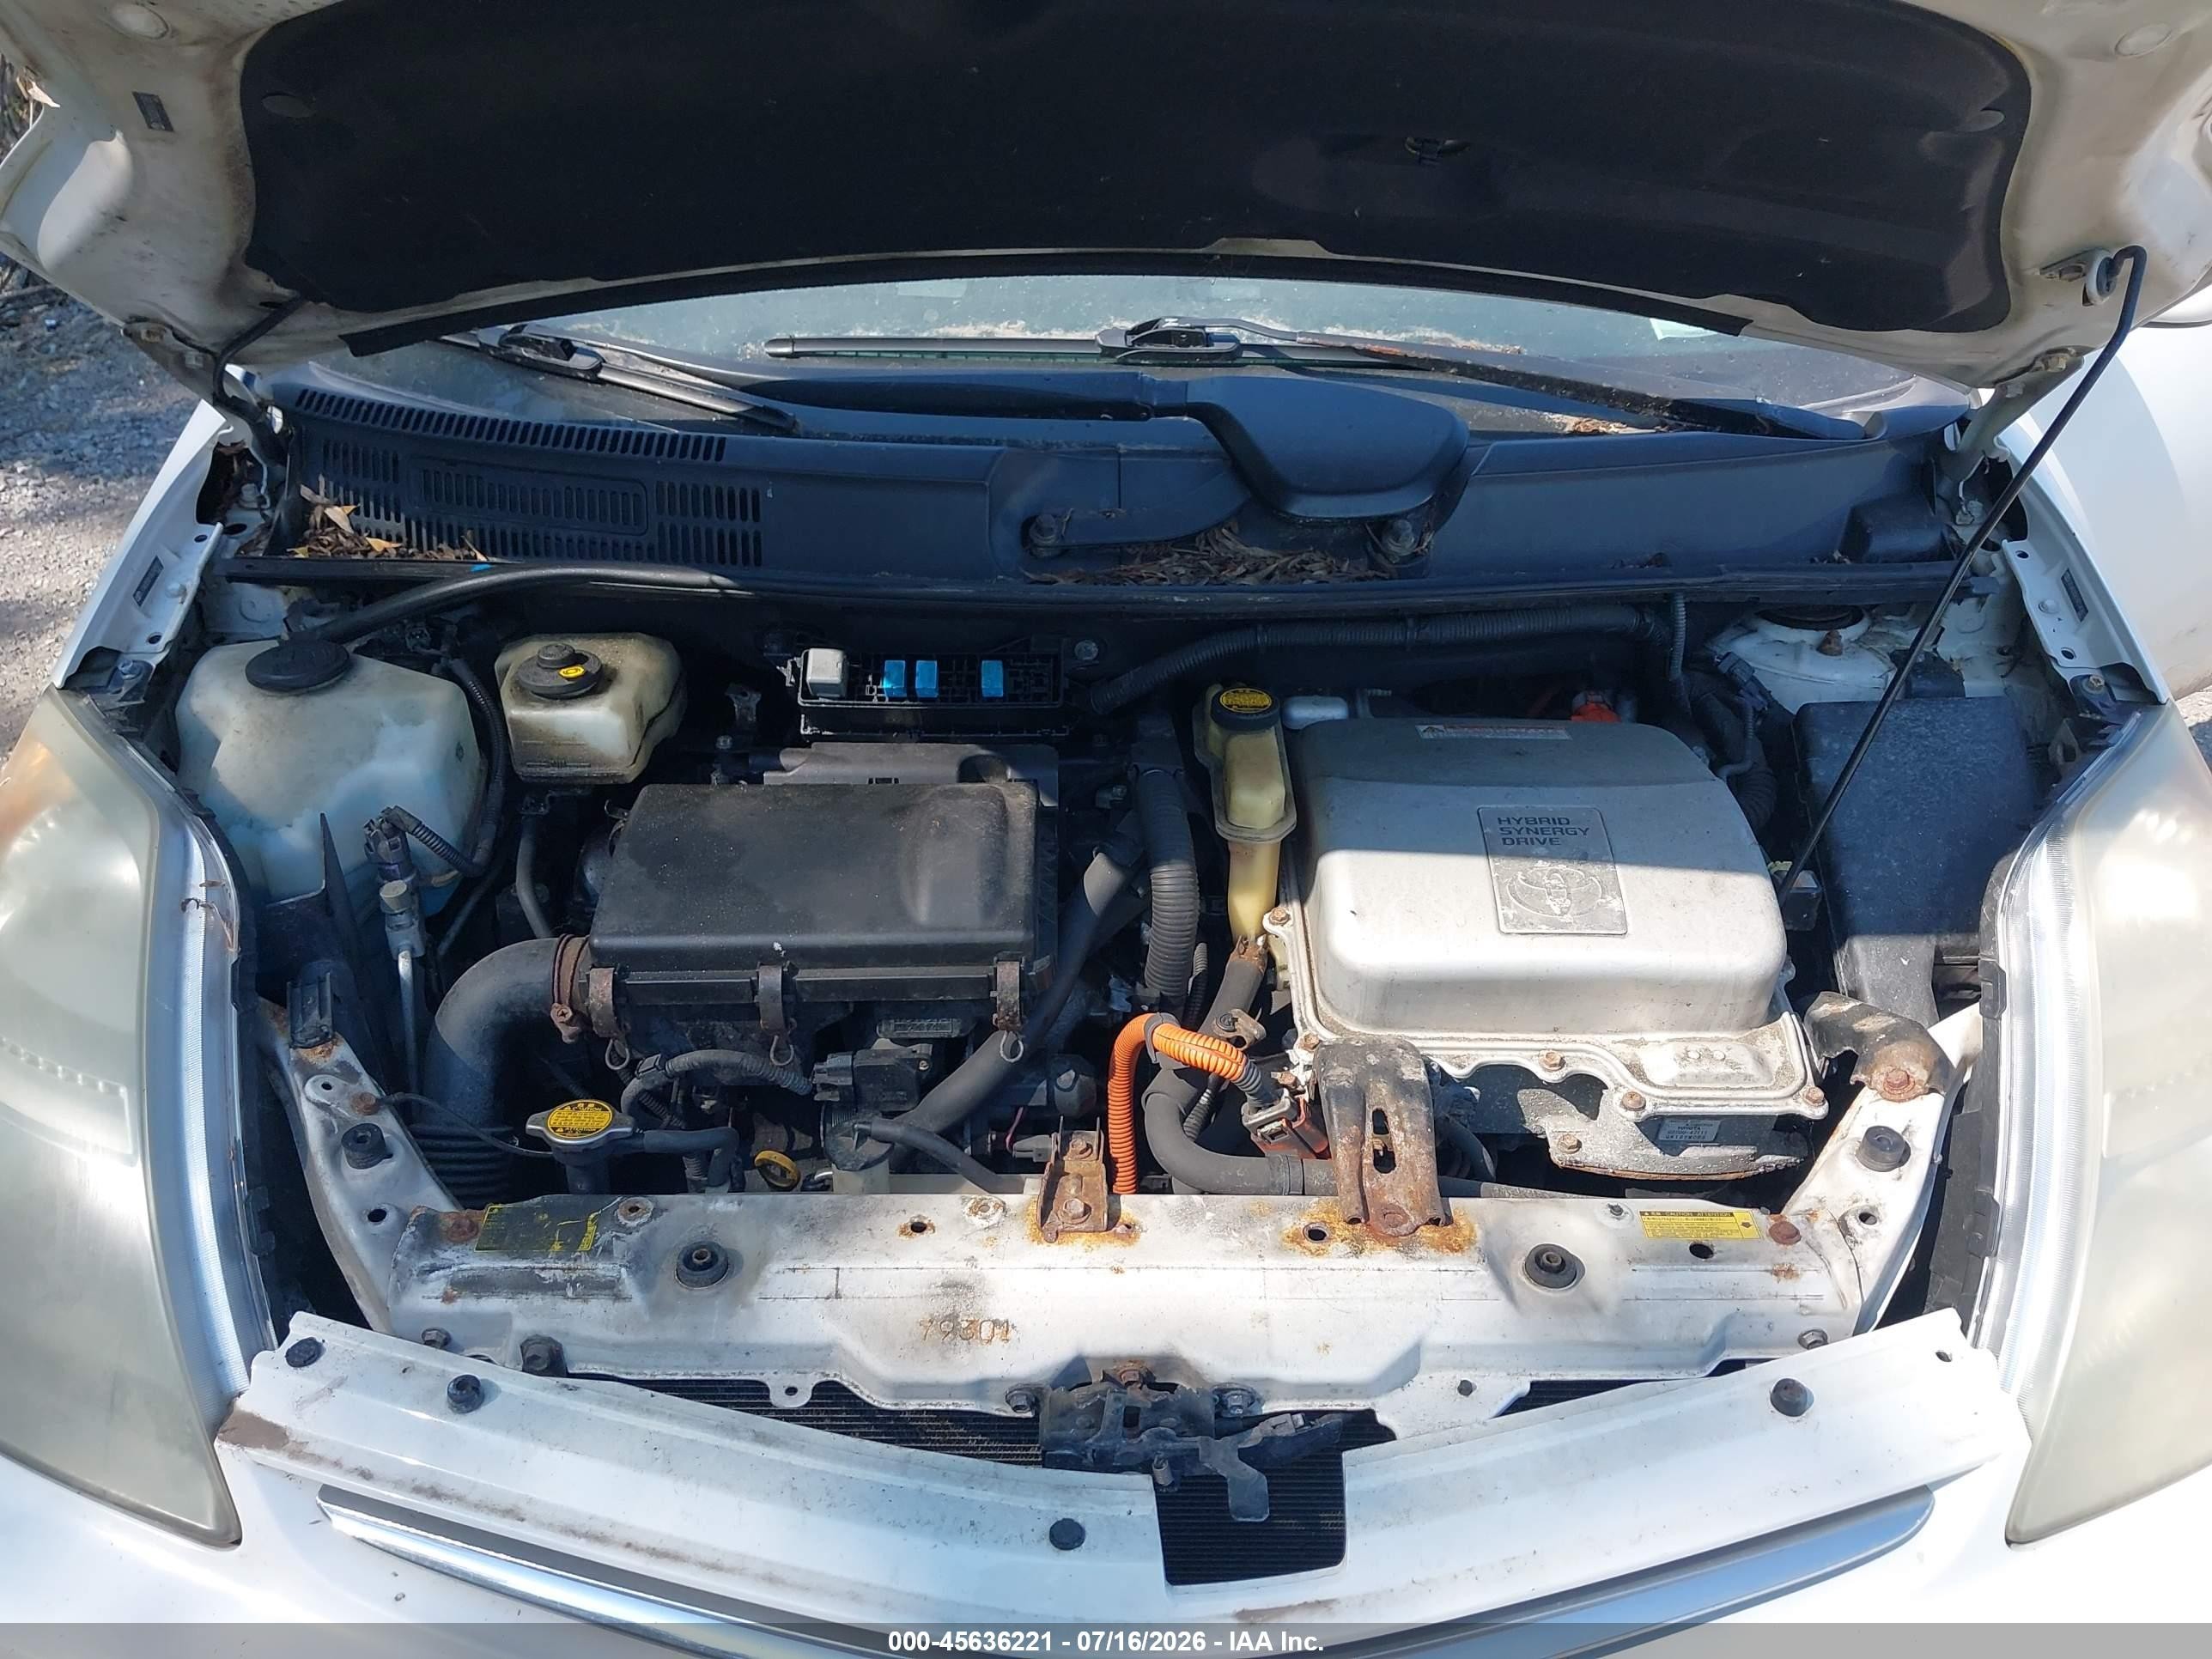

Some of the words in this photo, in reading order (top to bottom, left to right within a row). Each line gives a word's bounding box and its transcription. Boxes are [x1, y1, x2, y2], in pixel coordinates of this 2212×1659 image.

[1498, 817, 1571, 826] HYBRID
[1499, 827, 1589, 836] SYNERGY
[1503, 837, 1562, 846] DRIVE
